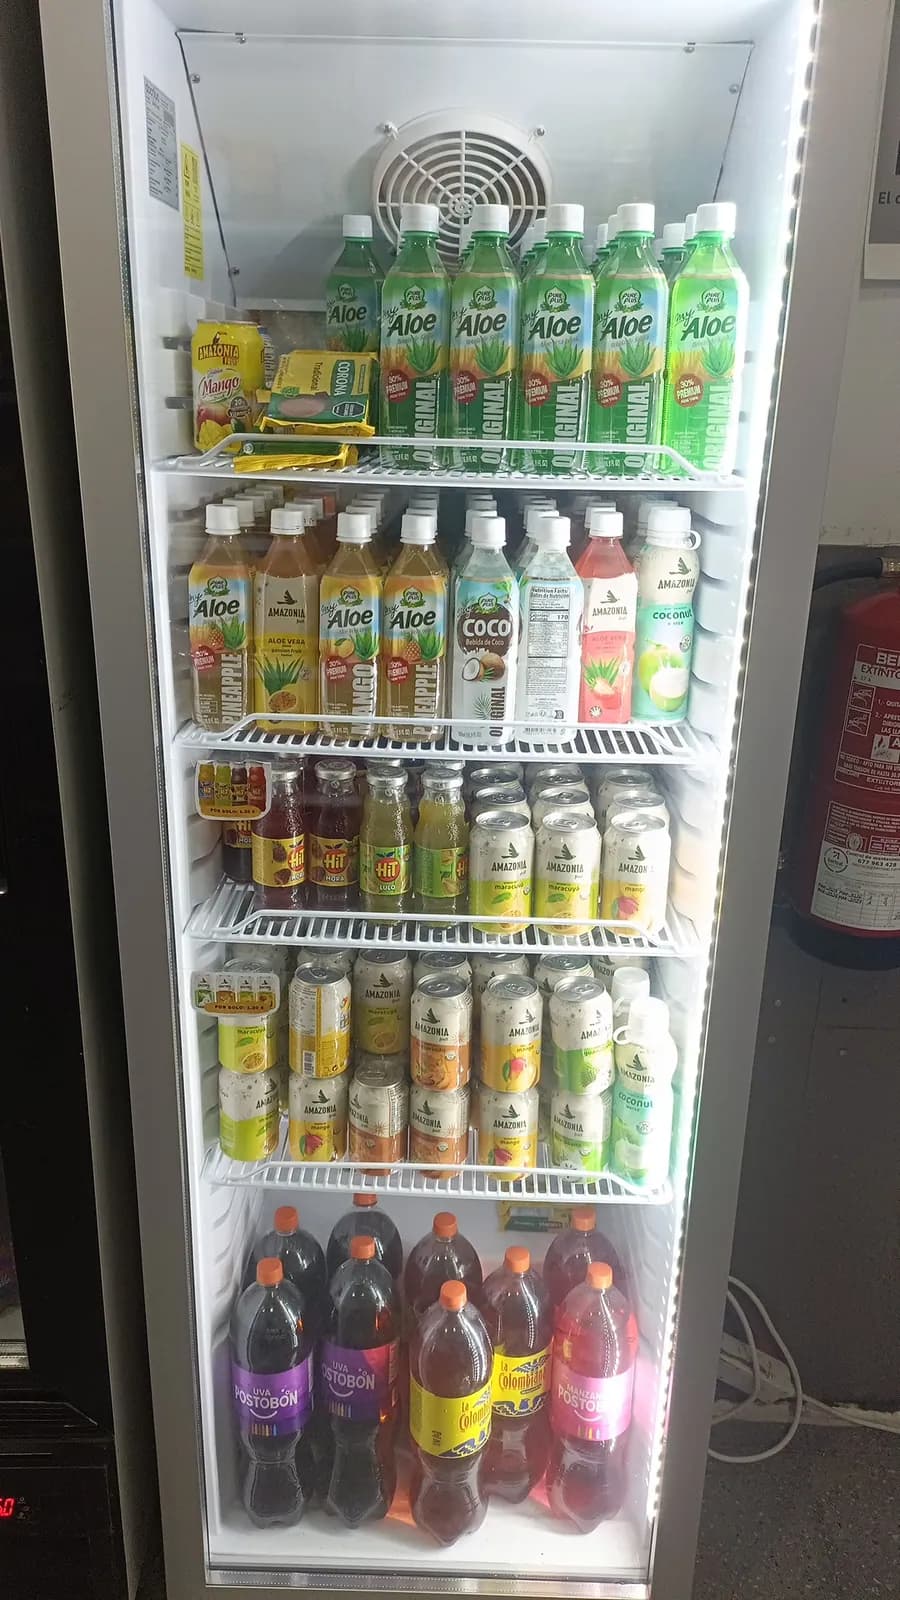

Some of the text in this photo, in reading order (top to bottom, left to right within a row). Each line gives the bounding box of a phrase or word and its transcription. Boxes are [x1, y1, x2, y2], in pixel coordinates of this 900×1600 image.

[878, 191, 891, 205] El
[328, 303, 368, 325] Aloe
[387, 312, 437, 338] Aloe
[455, 312, 507, 338] Aloe
[528, 315, 581, 341] Aloe
[600, 314, 652, 341] Aloe
[681, 315, 736, 341] Aloe
[311, 361, 323, 391] Tradicional
[334, 361, 350, 397] CORONA
[202, 376, 240, 397] Mango
[193, 599, 240, 618] Aloe
[268, 608, 305, 619] AMAZONIA
[592, 606, 628, 617] AMAZONIA
[327, 609, 374, 630] Aloe
[390, 610, 437, 630] Aloe
[462, 618, 511, 638] COCO
[465, 638, 505, 647] Bebida de Coco
[221, 653, 242, 725] PINEAPPLE
[324, 854, 347, 869] HiT
[375, 861, 399, 877] HiT
[491, 859, 527, 873] AMAZONIA
[546, 863, 584, 873] AMAZONIA
[366, 989, 400, 999] AMAZONIA
[304, 1105, 337, 1114] AMAZONIA
[493, 1119, 527, 1129] AMAZONIA
[332, 1360, 349, 1373] UVA
[500, 1360, 508, 1372] La
[253, 1388, 271, 1397] UVA
[461, 1402, 469, 1413] La
